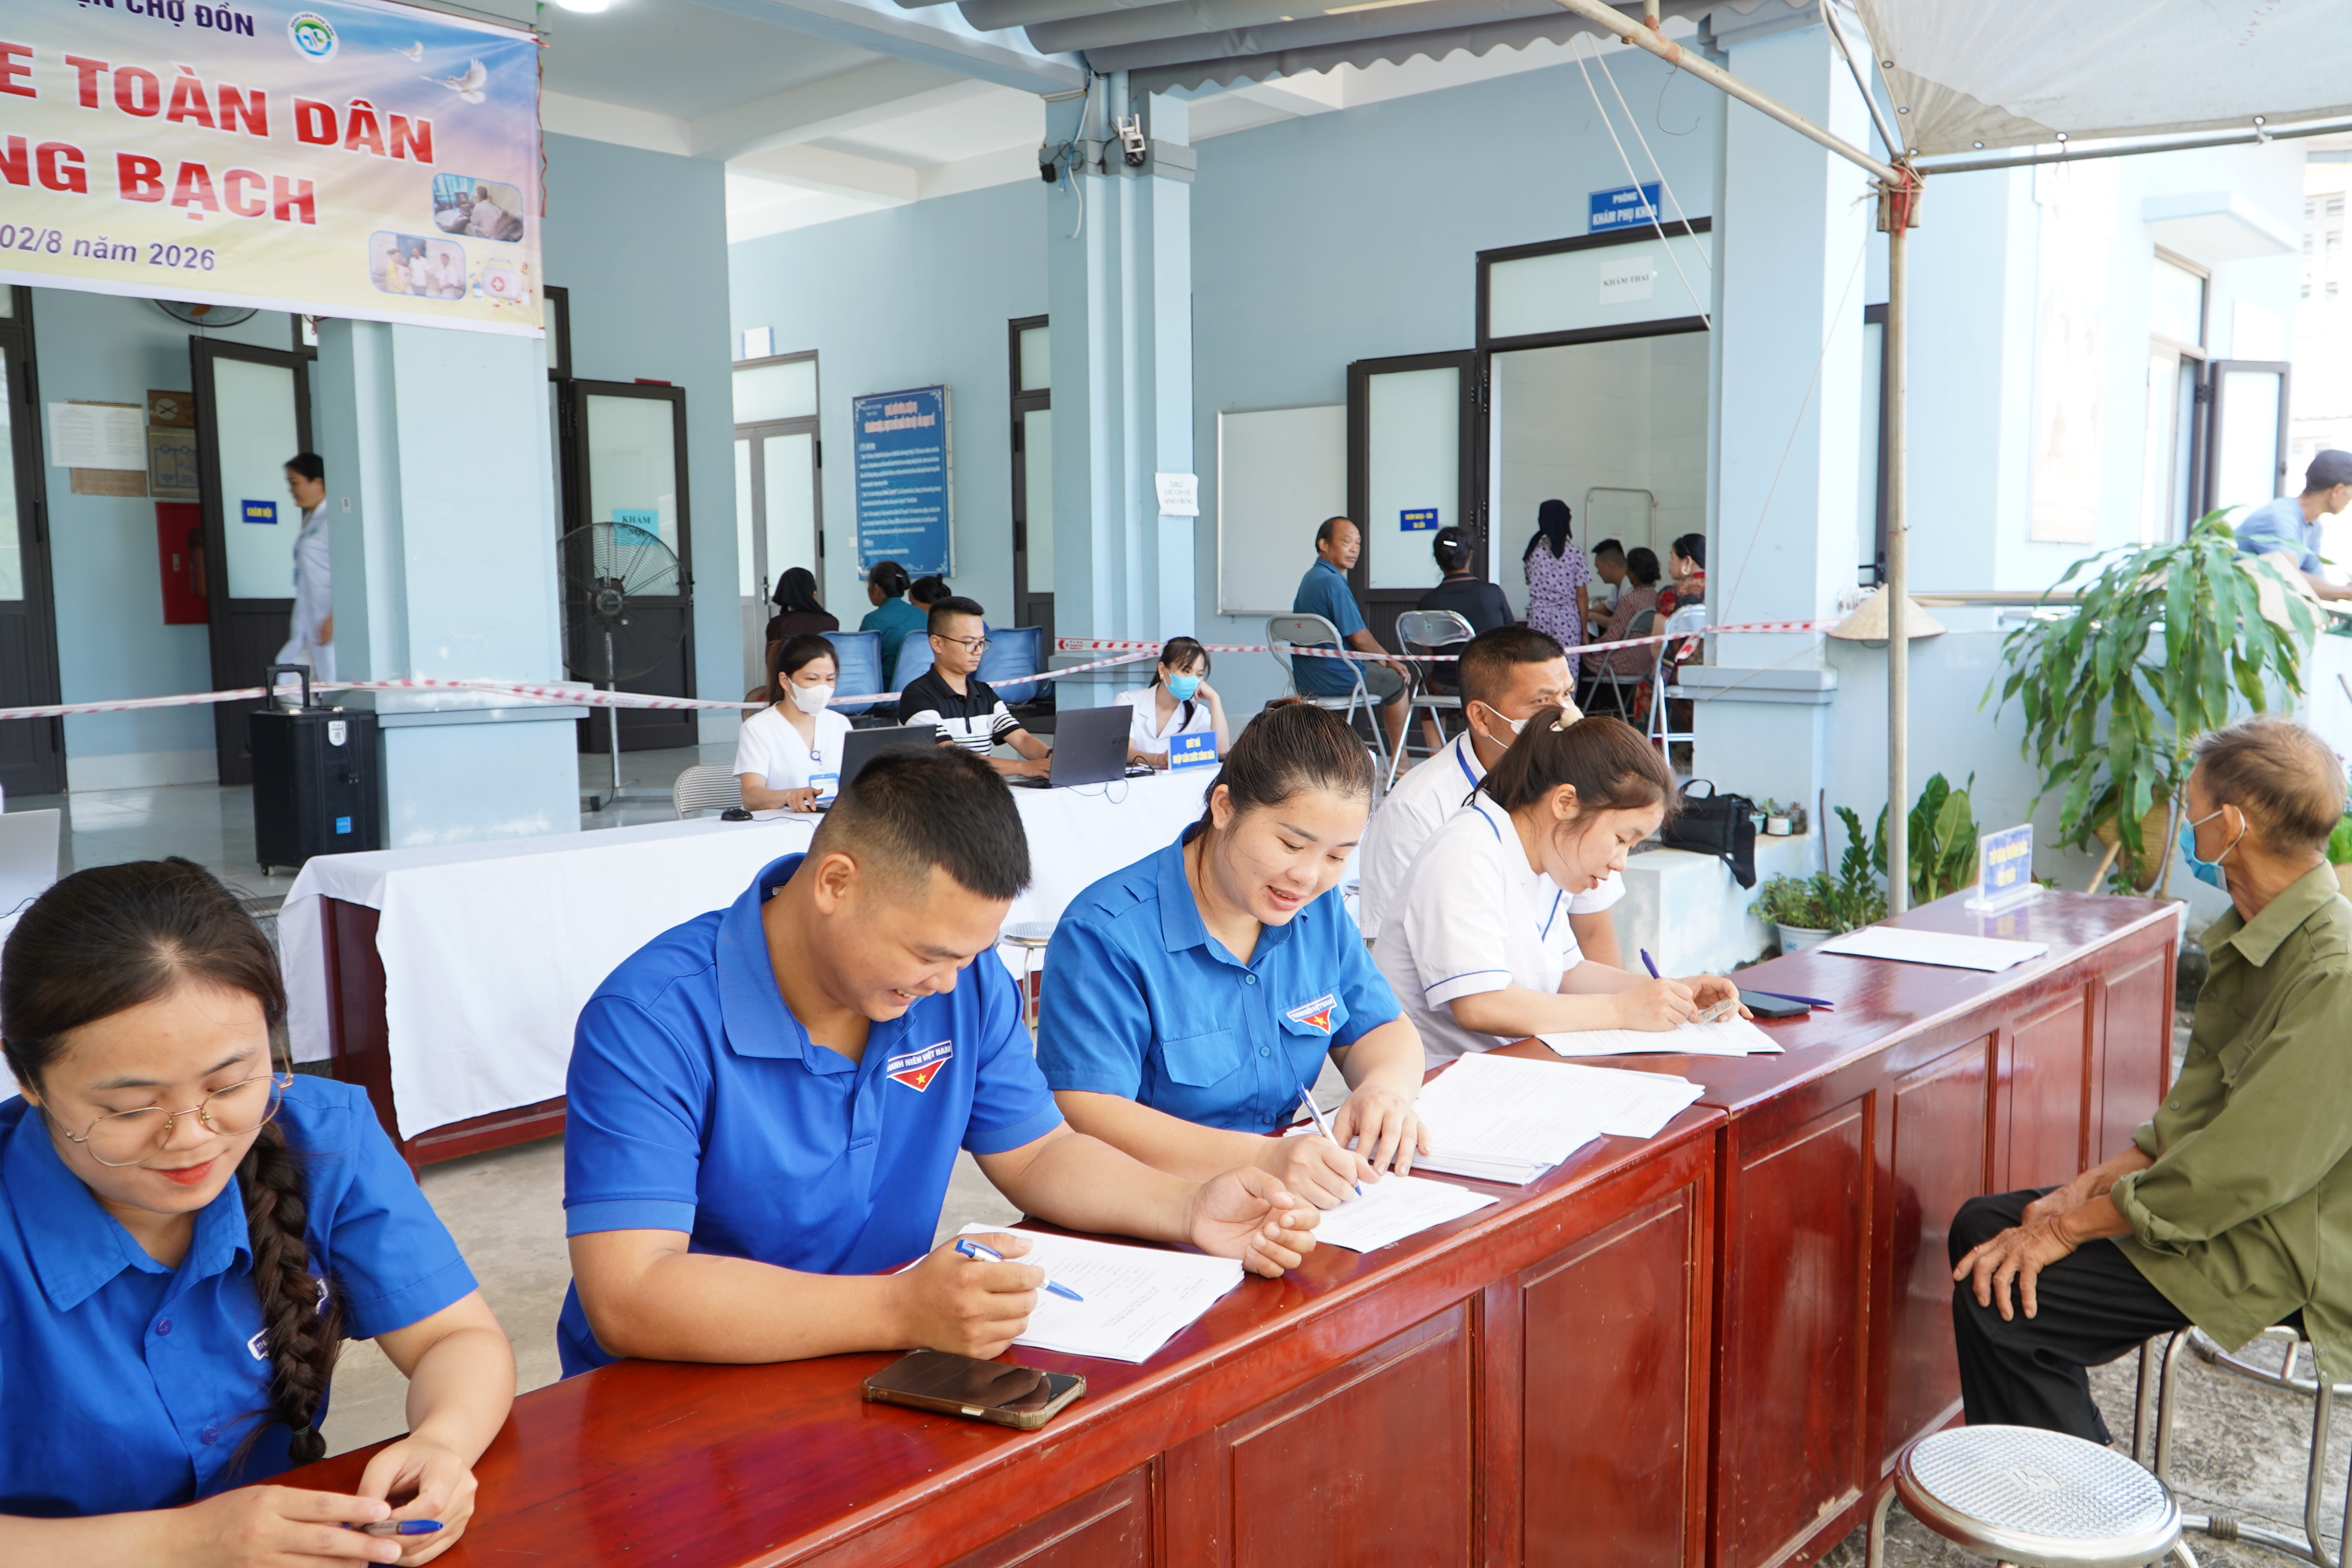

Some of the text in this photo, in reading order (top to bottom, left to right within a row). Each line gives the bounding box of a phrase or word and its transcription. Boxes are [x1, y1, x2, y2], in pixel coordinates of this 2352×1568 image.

[126, 0, 255, 36] CHỢ ĐỒN
[65, 54, 269, 137] TOÀN
[294, 96, 434, 164] DÂN
[117, 152, 317, 225] BẠCH
[1592, 209, 1616, 226] KHÁM
[72, 235, 137, 262] năm
[149, 243, 215, 271] 2026
[622, 513, 650, 525] KHÁM
[905, 1055, 923, 1067] NIÊN
[922, 1050, 935, 1061] VIỆT
[935, 1045, 952, 1056] NAM
